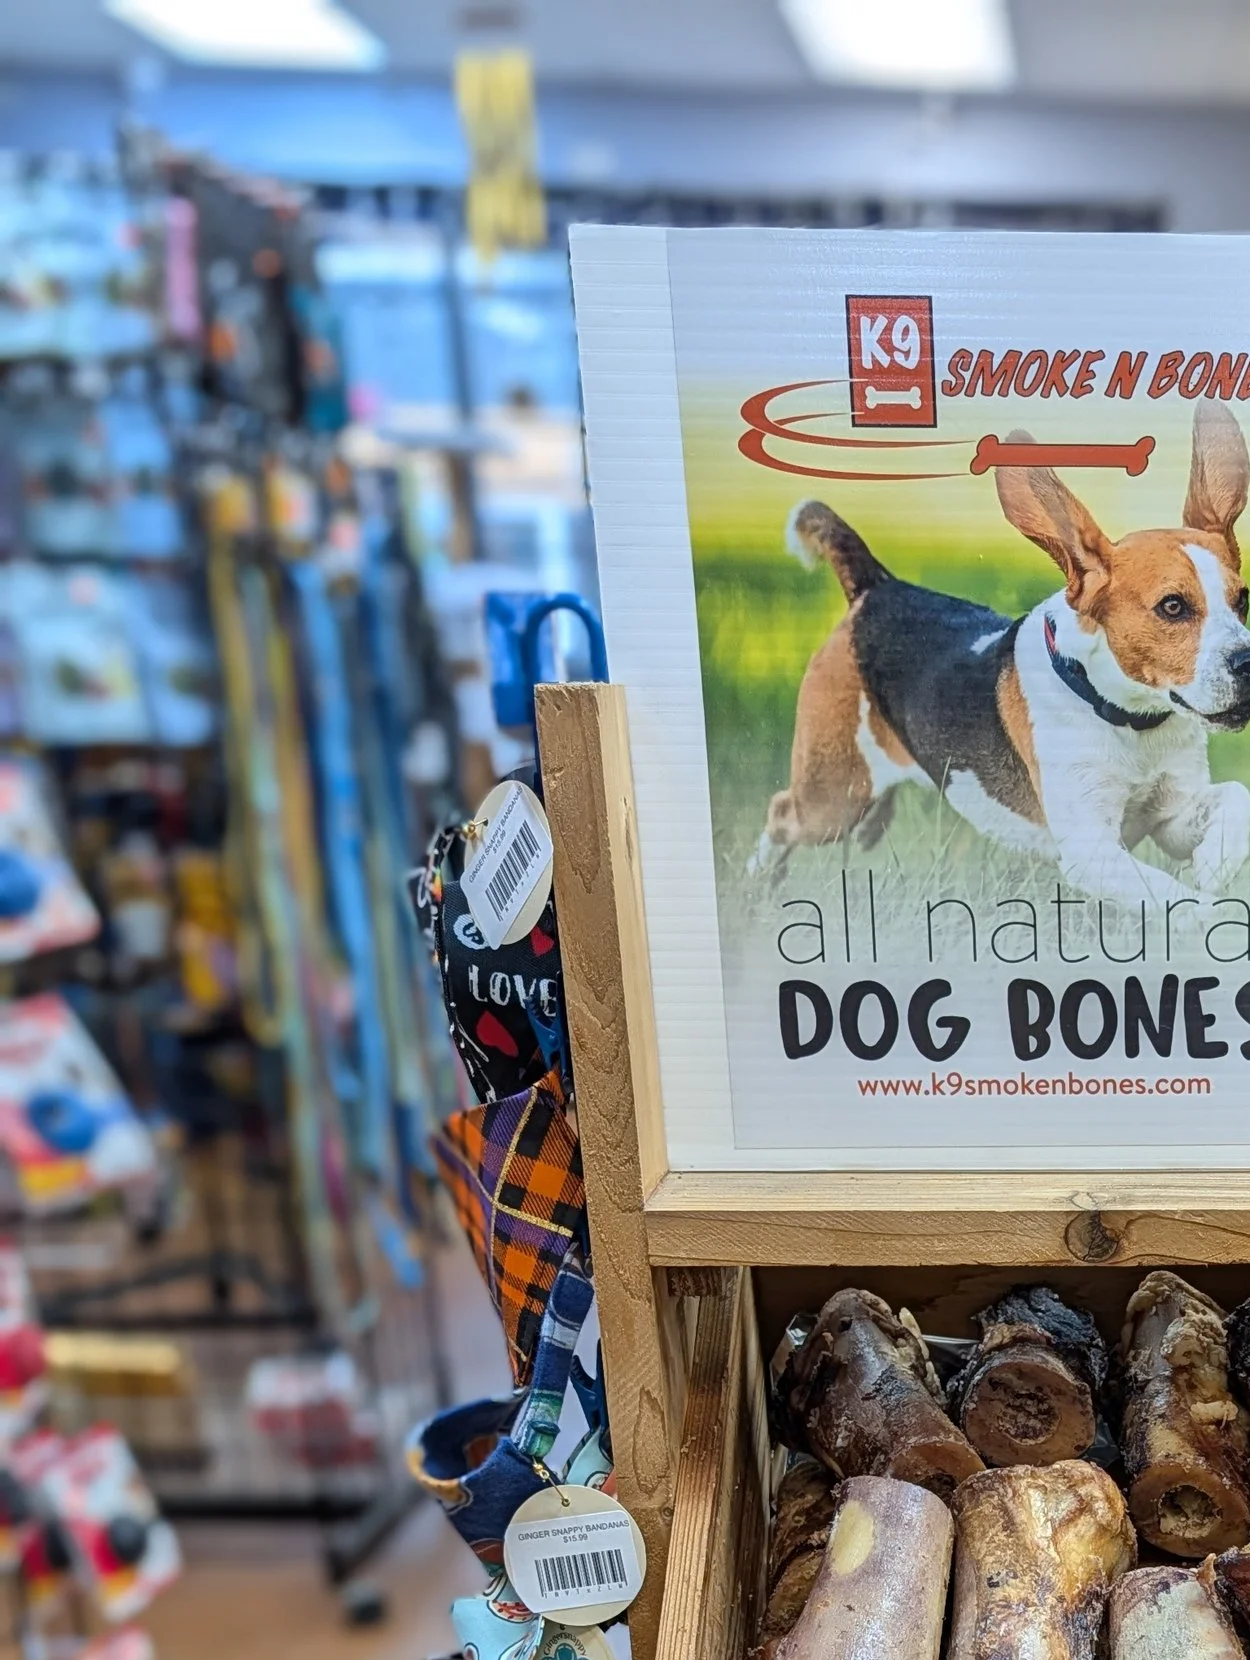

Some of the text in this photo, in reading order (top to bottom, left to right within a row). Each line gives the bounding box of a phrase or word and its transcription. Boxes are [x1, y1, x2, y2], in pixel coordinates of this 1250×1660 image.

[857, 314, 922, 370] K9
[941, 348, 1106, 399] SMOKE
[1105, 350, 1150, 399] N
[469, 853, 487, 883] GINGER
[485, 826, 502, 855] SNAPPY
[776, 869, 878, 964] all
[468, 963, 557, 1017] LOVE
[778, 978, 971, 1062] DOG
[857, 1072, 1211, 1100] www.k9smokenbones.com
[518, 1519, 630, 1541] GINGER SNAPPY BANDANAS
[563, 1534, 588, 1544] $15.99
